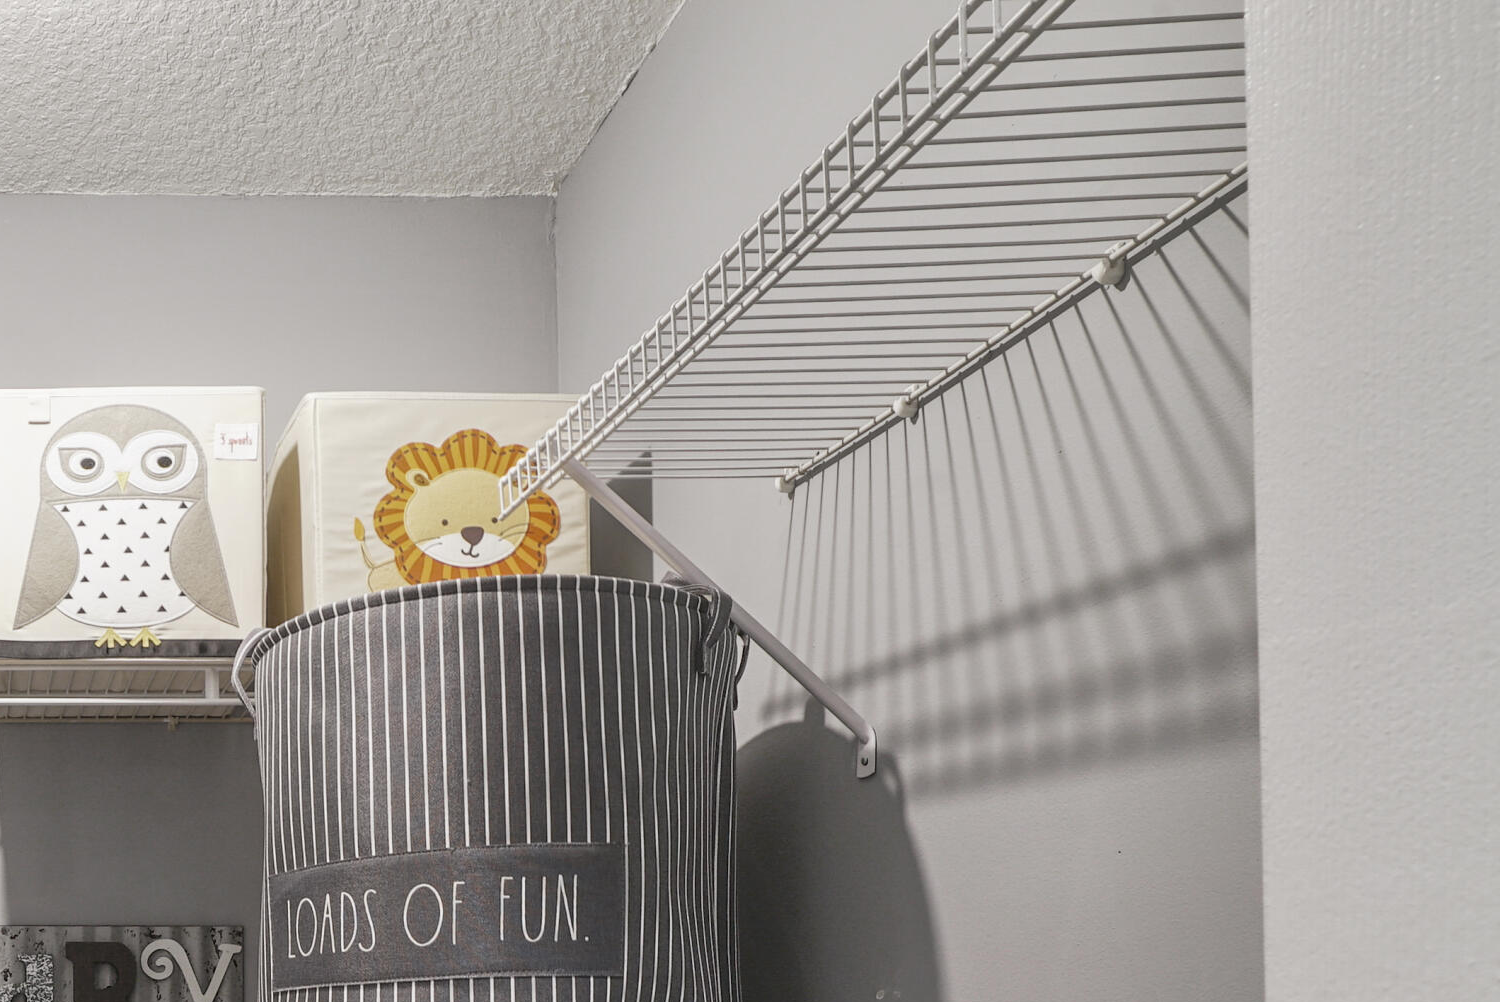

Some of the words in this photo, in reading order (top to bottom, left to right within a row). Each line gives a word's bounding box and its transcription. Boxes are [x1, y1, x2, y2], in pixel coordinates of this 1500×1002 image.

[287, 889, 377, 958] LOADS
[404, 881, 465, 947] OF
[500, 874, 589, 942] FUN.
